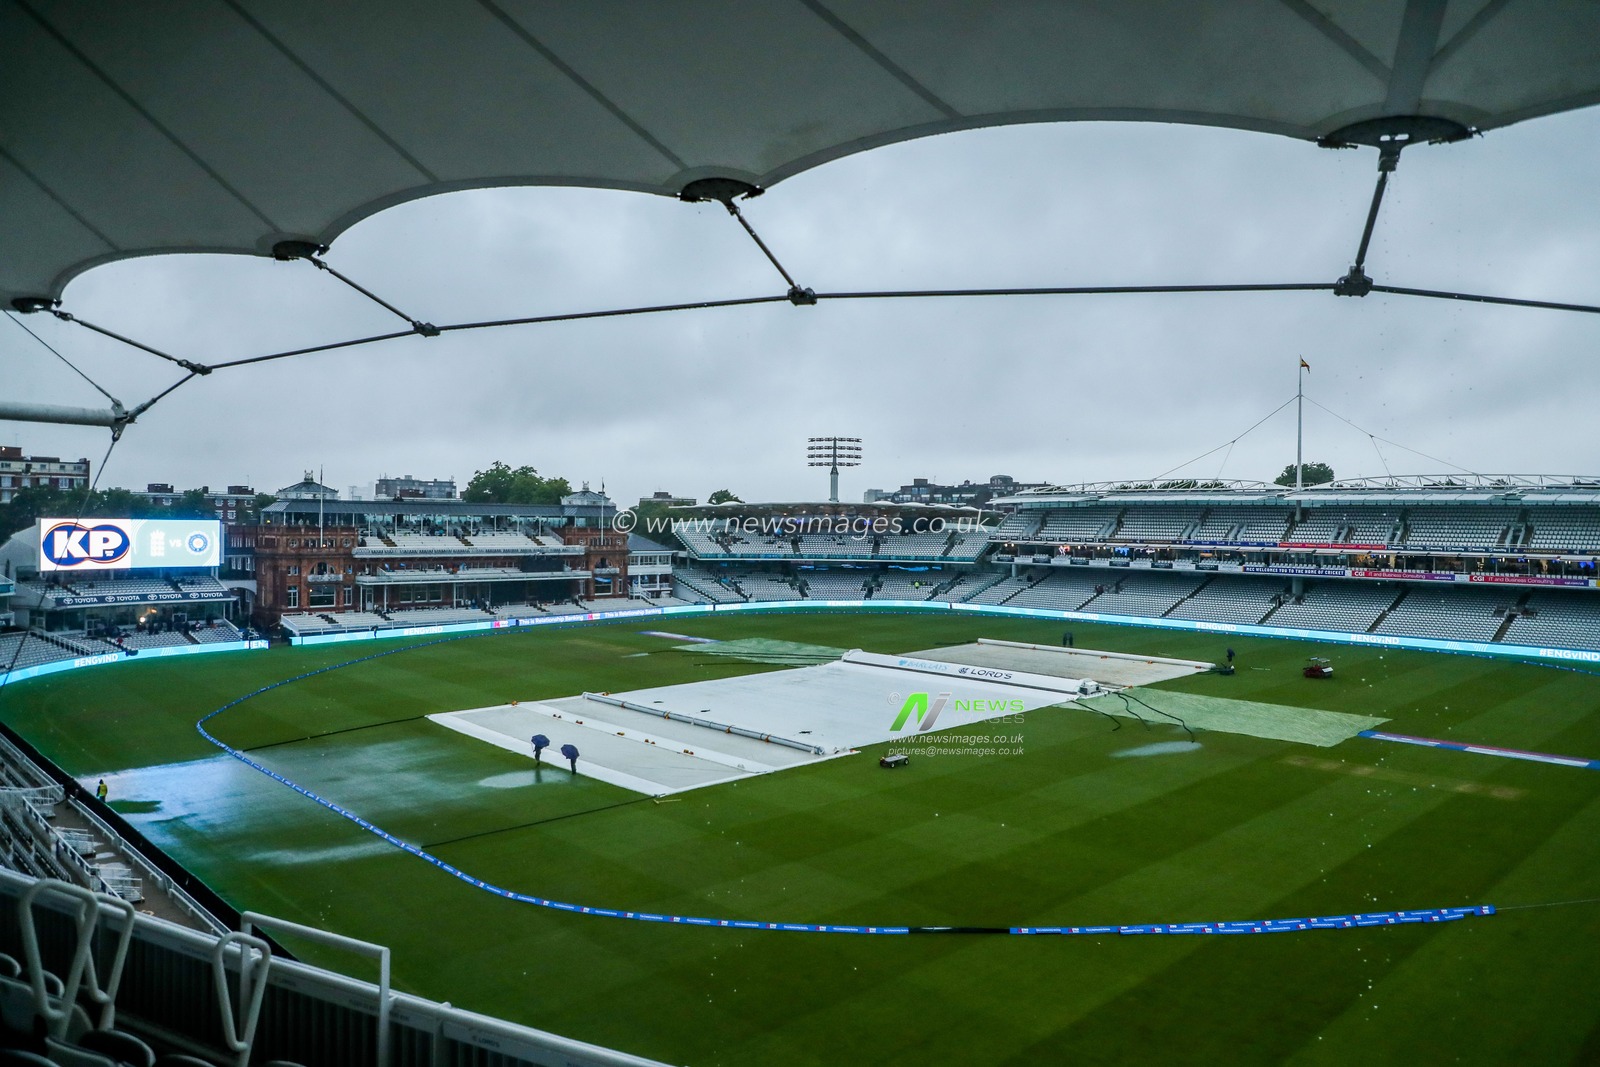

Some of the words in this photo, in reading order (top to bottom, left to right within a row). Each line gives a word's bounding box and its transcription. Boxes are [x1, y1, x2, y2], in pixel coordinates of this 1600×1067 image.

[535, 616, 564, 624] Relationship
[1539, 648, 1600, 660] #ENGvIND
[74, 653, 119, 668] #ENGvIND
[907, 661, 948, 671] BARCLAYS
[970, 668, 1012, 680] LORD'S
